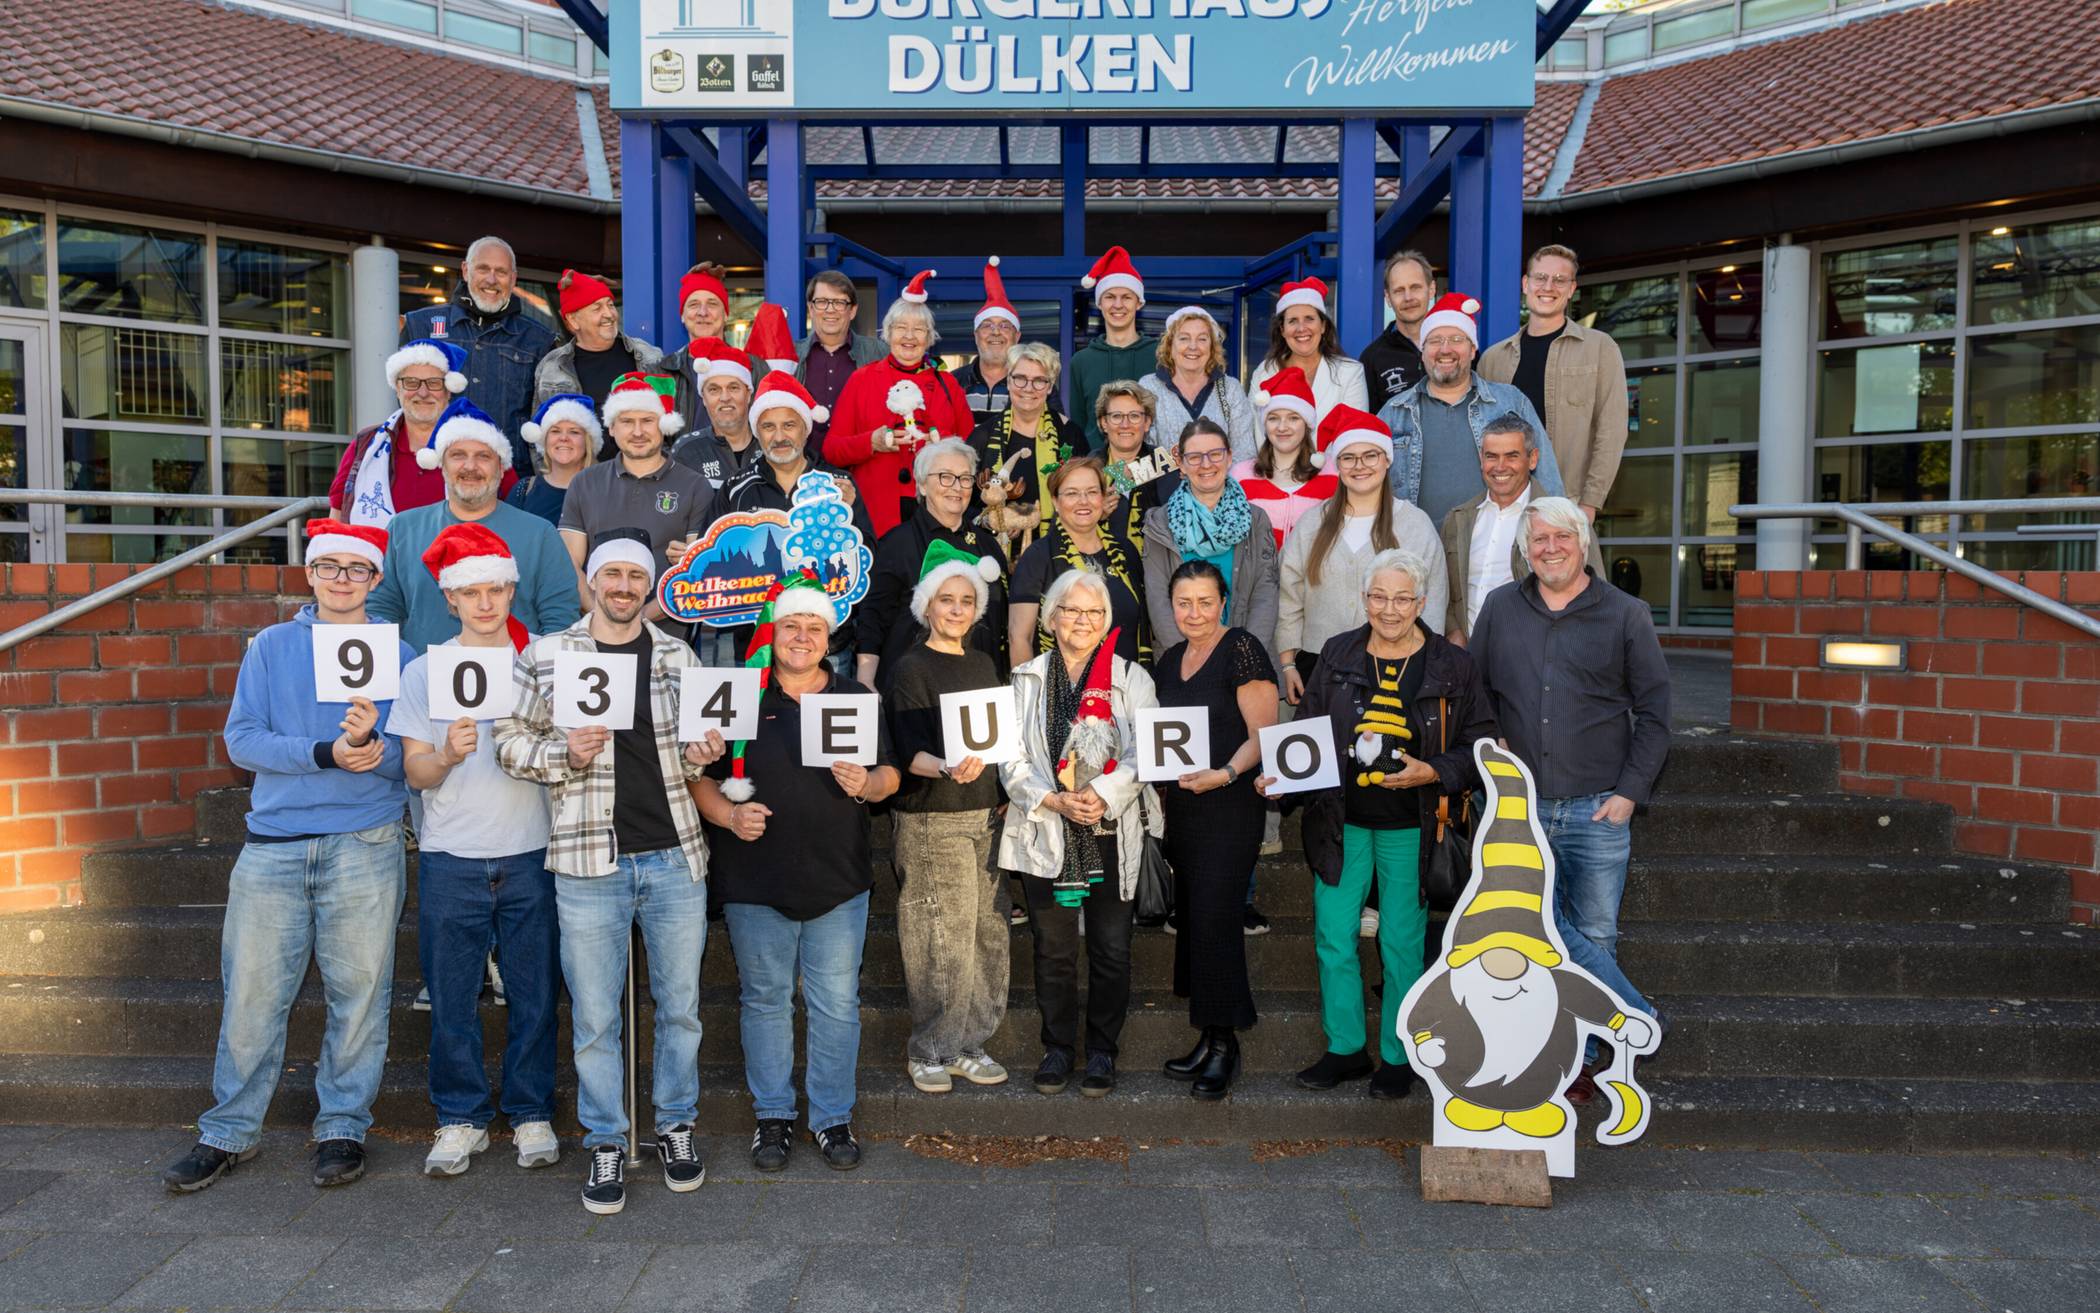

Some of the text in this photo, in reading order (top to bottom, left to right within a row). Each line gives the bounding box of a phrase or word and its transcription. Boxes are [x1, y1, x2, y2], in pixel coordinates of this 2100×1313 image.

[888, 26, 1194, 94] DÜLKEN
[1285, 32, 1518, 96] Willkommen
[1103, 446, 1180, 495] XMA
[672, 574, 776, 596] Dülkener
[337, 639, 374, 688] 9
[452, 661, 487, 708] 0
[576, 667, 611, 716] 3
[701, 681, 736, 727] 4
[821, 708, 859, 754] E
[959, 702, 999, 751] U
[1153, 721, 1195, 767] R
[1276, 734, 1321, 780] O
